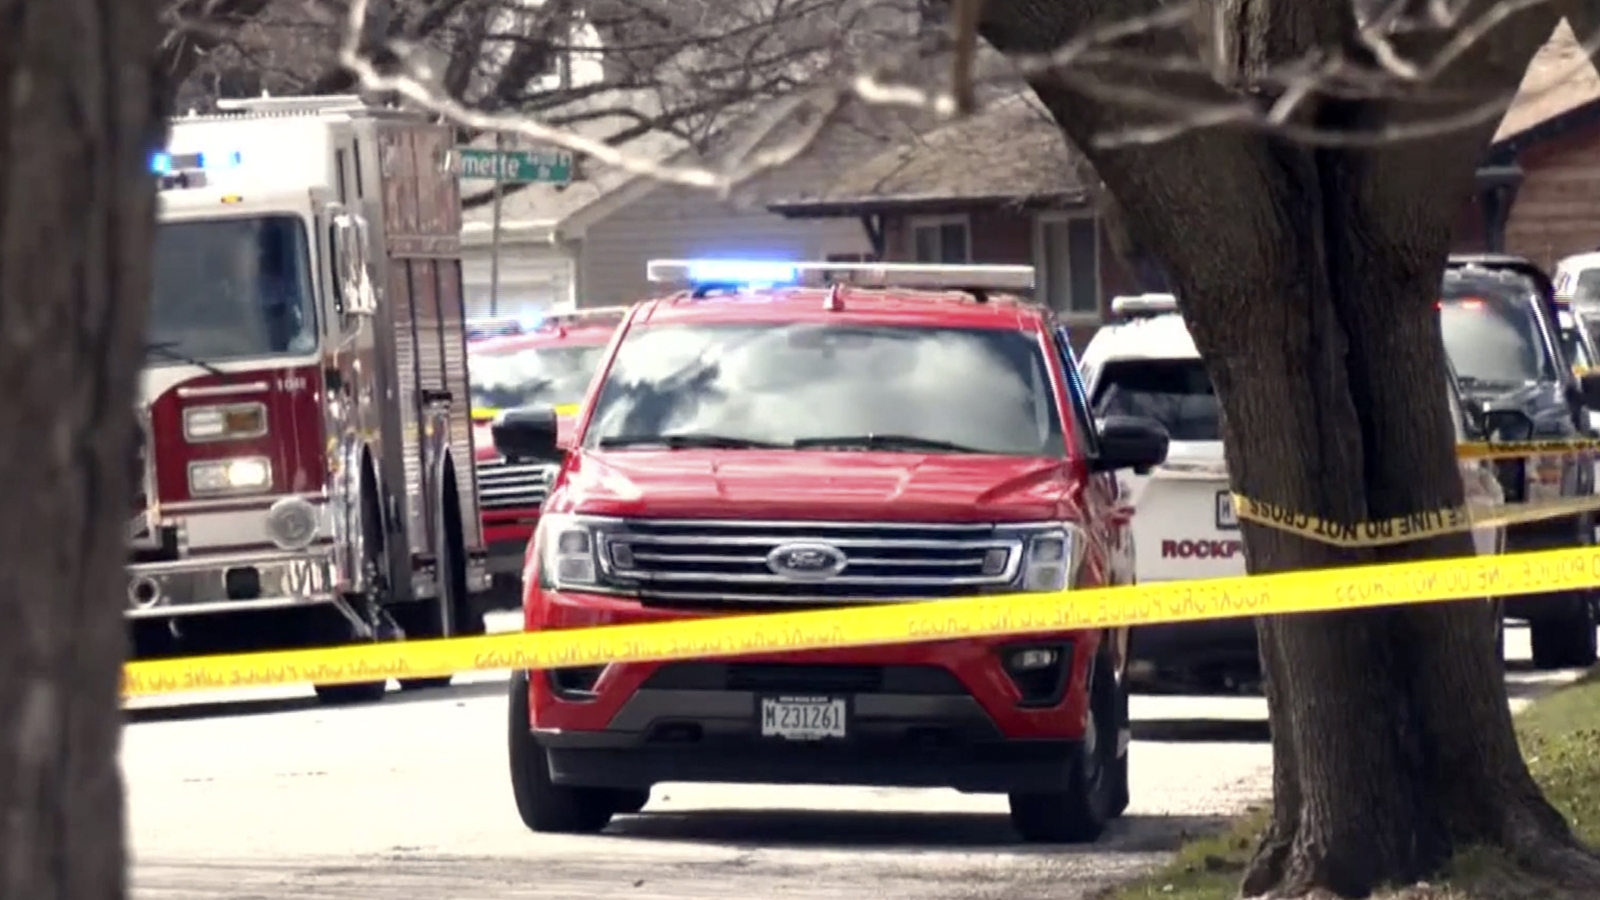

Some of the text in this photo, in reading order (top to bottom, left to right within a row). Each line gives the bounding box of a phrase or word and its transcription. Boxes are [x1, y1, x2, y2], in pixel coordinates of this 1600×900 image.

[461, 153, 520, 178] mette
[1249, 500, 1309, 530] CROSS
[1315, 513, 1358, 540] NOT
[1365, 516, 1392, 539] DO
[1399, 508, 1443, 536] LINE
[1161, 539, 1243, 558] ROCKF
[780, 706, 841, 730] 231261
